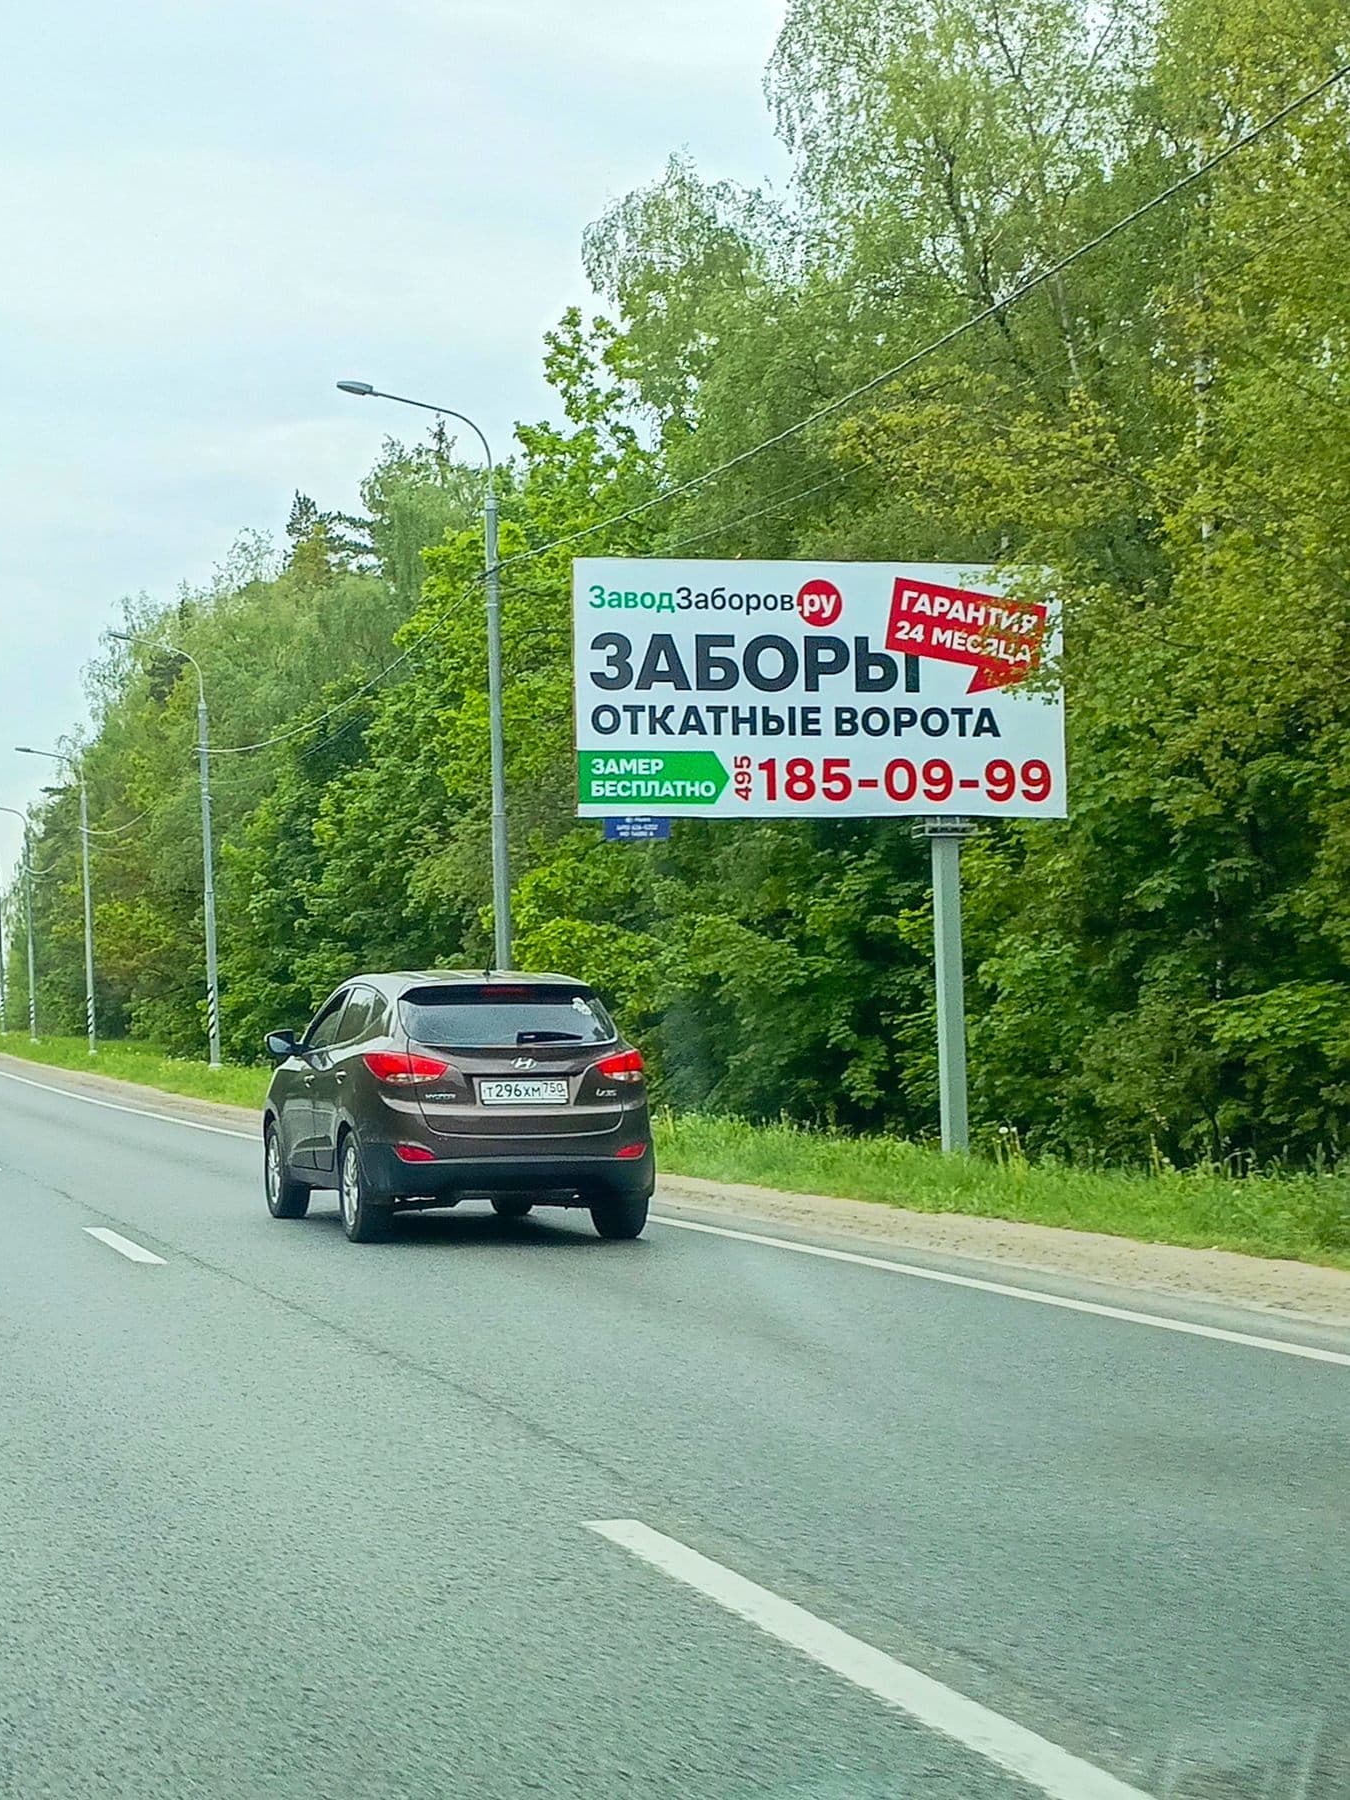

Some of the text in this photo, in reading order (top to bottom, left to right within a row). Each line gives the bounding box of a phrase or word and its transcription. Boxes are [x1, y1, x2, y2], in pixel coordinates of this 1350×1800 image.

[900, 589, 1039, 635] ГАРАНТИЯ
[589, 631, 921, 693] ЗАБОРЫ
[894, 620, 1033, 665] 24 МЕСЯЦА
[590, 703, 1002, 738] ОТКАТНЫЕ ВОРОТА
[590, 757, 664, 776] ЗАМЕР
[590, 779, 717, 798] БЕСПЛАТНО
[733, 755, 753, 801] 495
[757, 757, 1052, 803] 185-09-99
